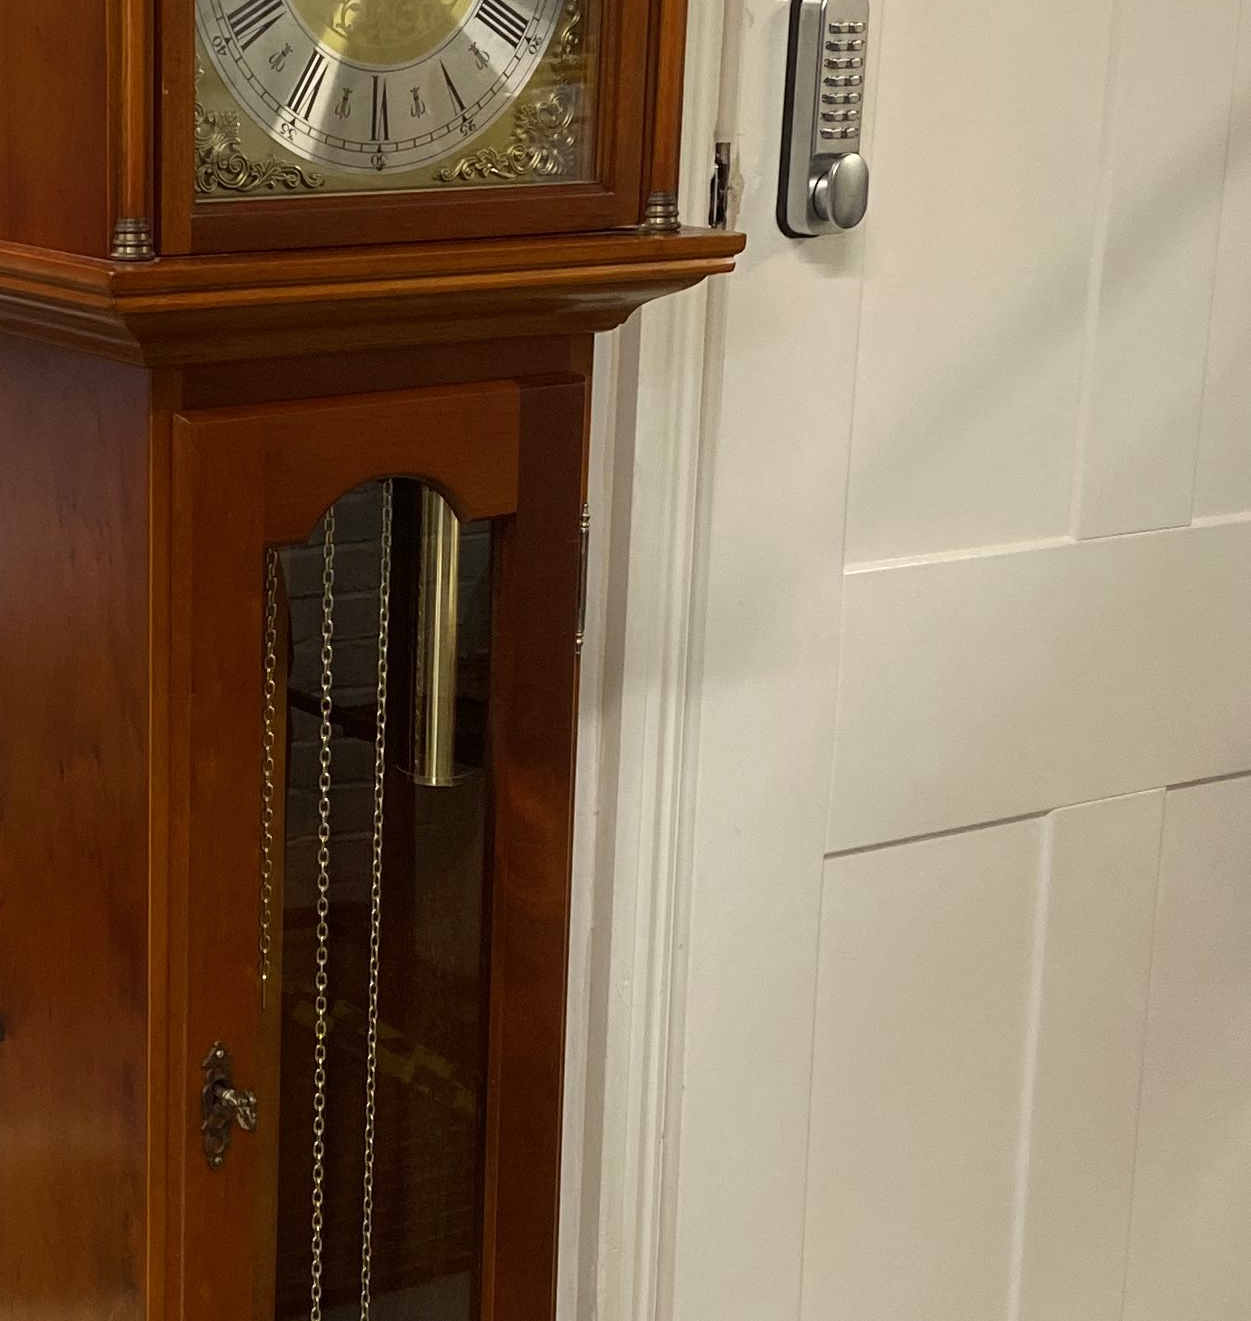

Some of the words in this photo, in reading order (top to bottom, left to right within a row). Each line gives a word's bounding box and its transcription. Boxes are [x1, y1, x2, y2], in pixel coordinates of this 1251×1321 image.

[212, 35, 227, 56] 40
[285, 46, 330, 122] VII
[439, 56, 467, 117] V
[371, 75, 390, 141] VI
[459, 118, 477, 137] 25
[280, 122, 295, 142] 35
